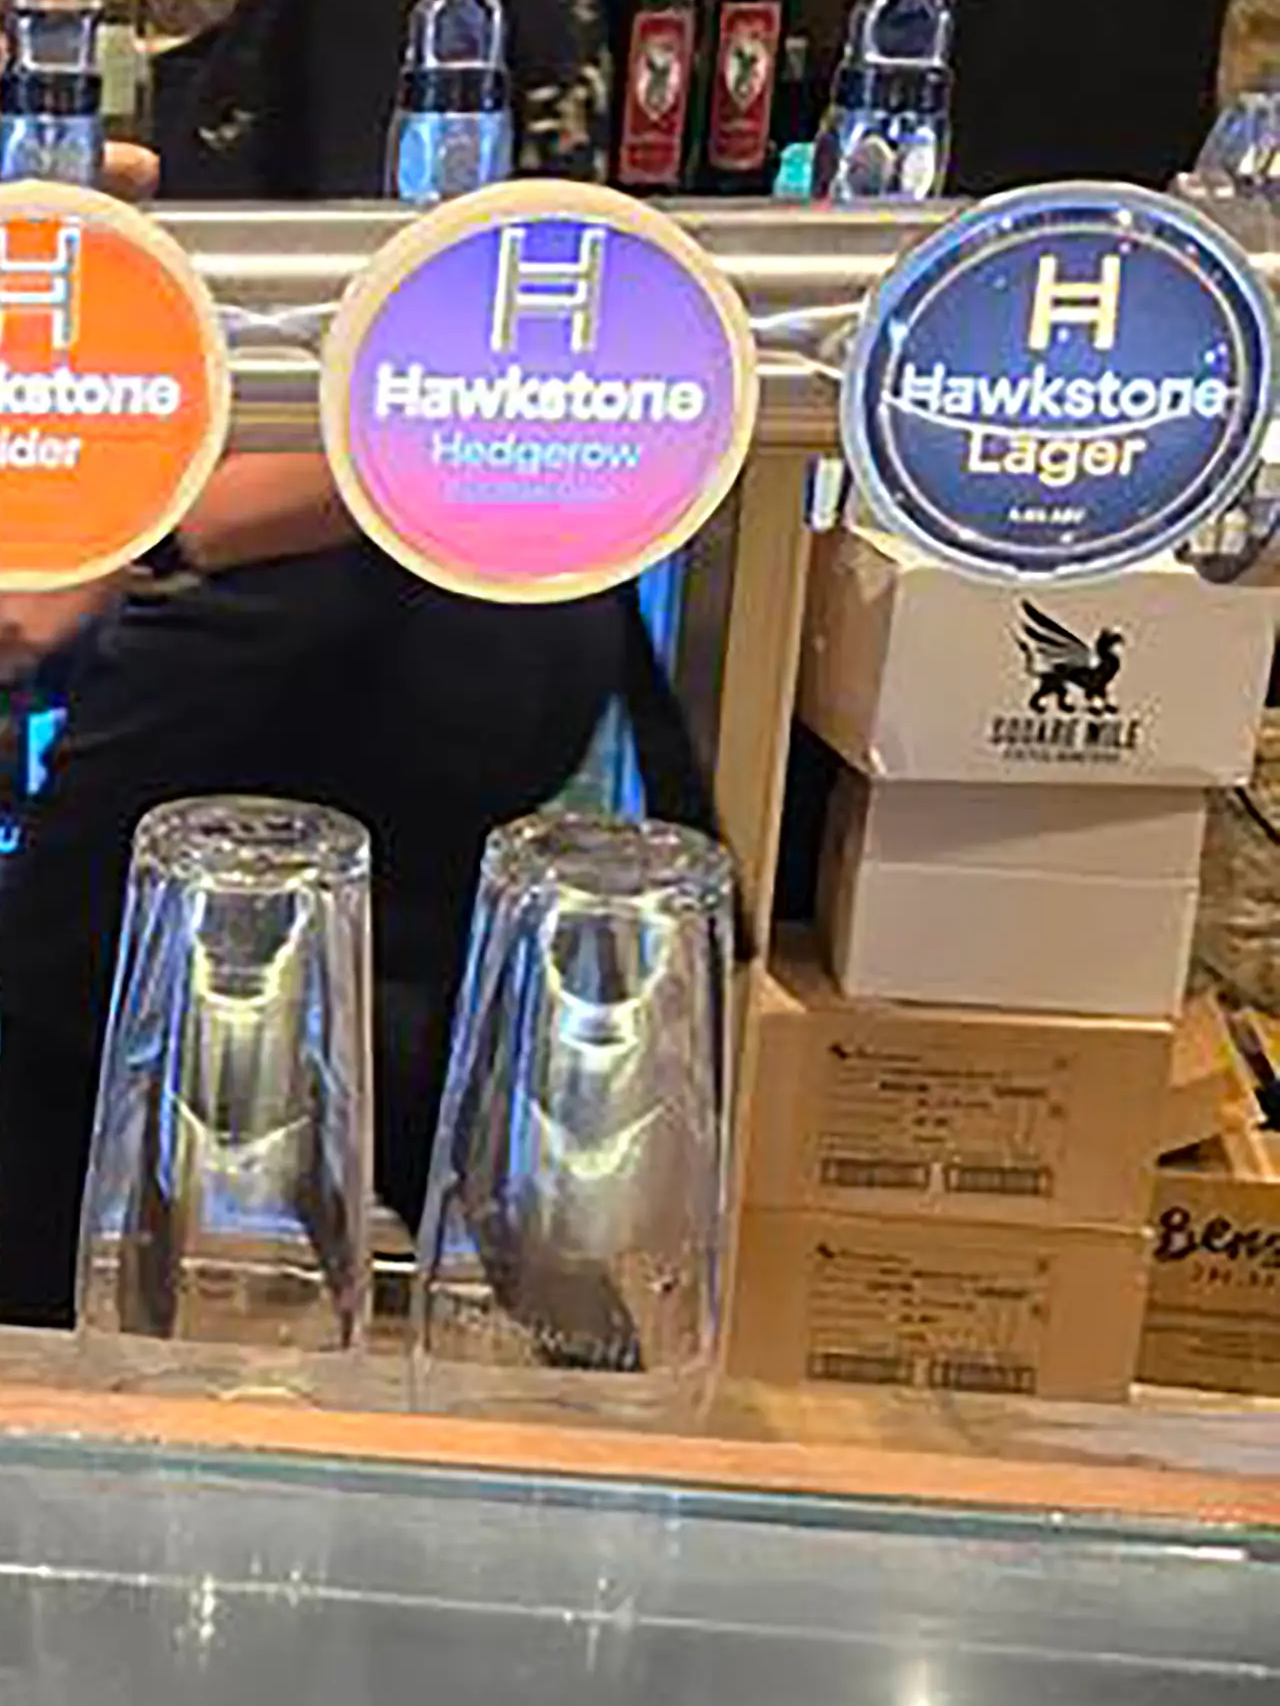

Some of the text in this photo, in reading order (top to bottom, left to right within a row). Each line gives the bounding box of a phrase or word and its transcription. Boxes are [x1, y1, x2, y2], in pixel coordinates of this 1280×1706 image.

[374, 362, 705, 423] Hawkstone
[901, 363, 1229, 417] Hawkstone
[430, 431, 641, 474] Hedgerow
[966, 431, 1147, 487] Lager
[1085, 719, 1140, 750] MILE
